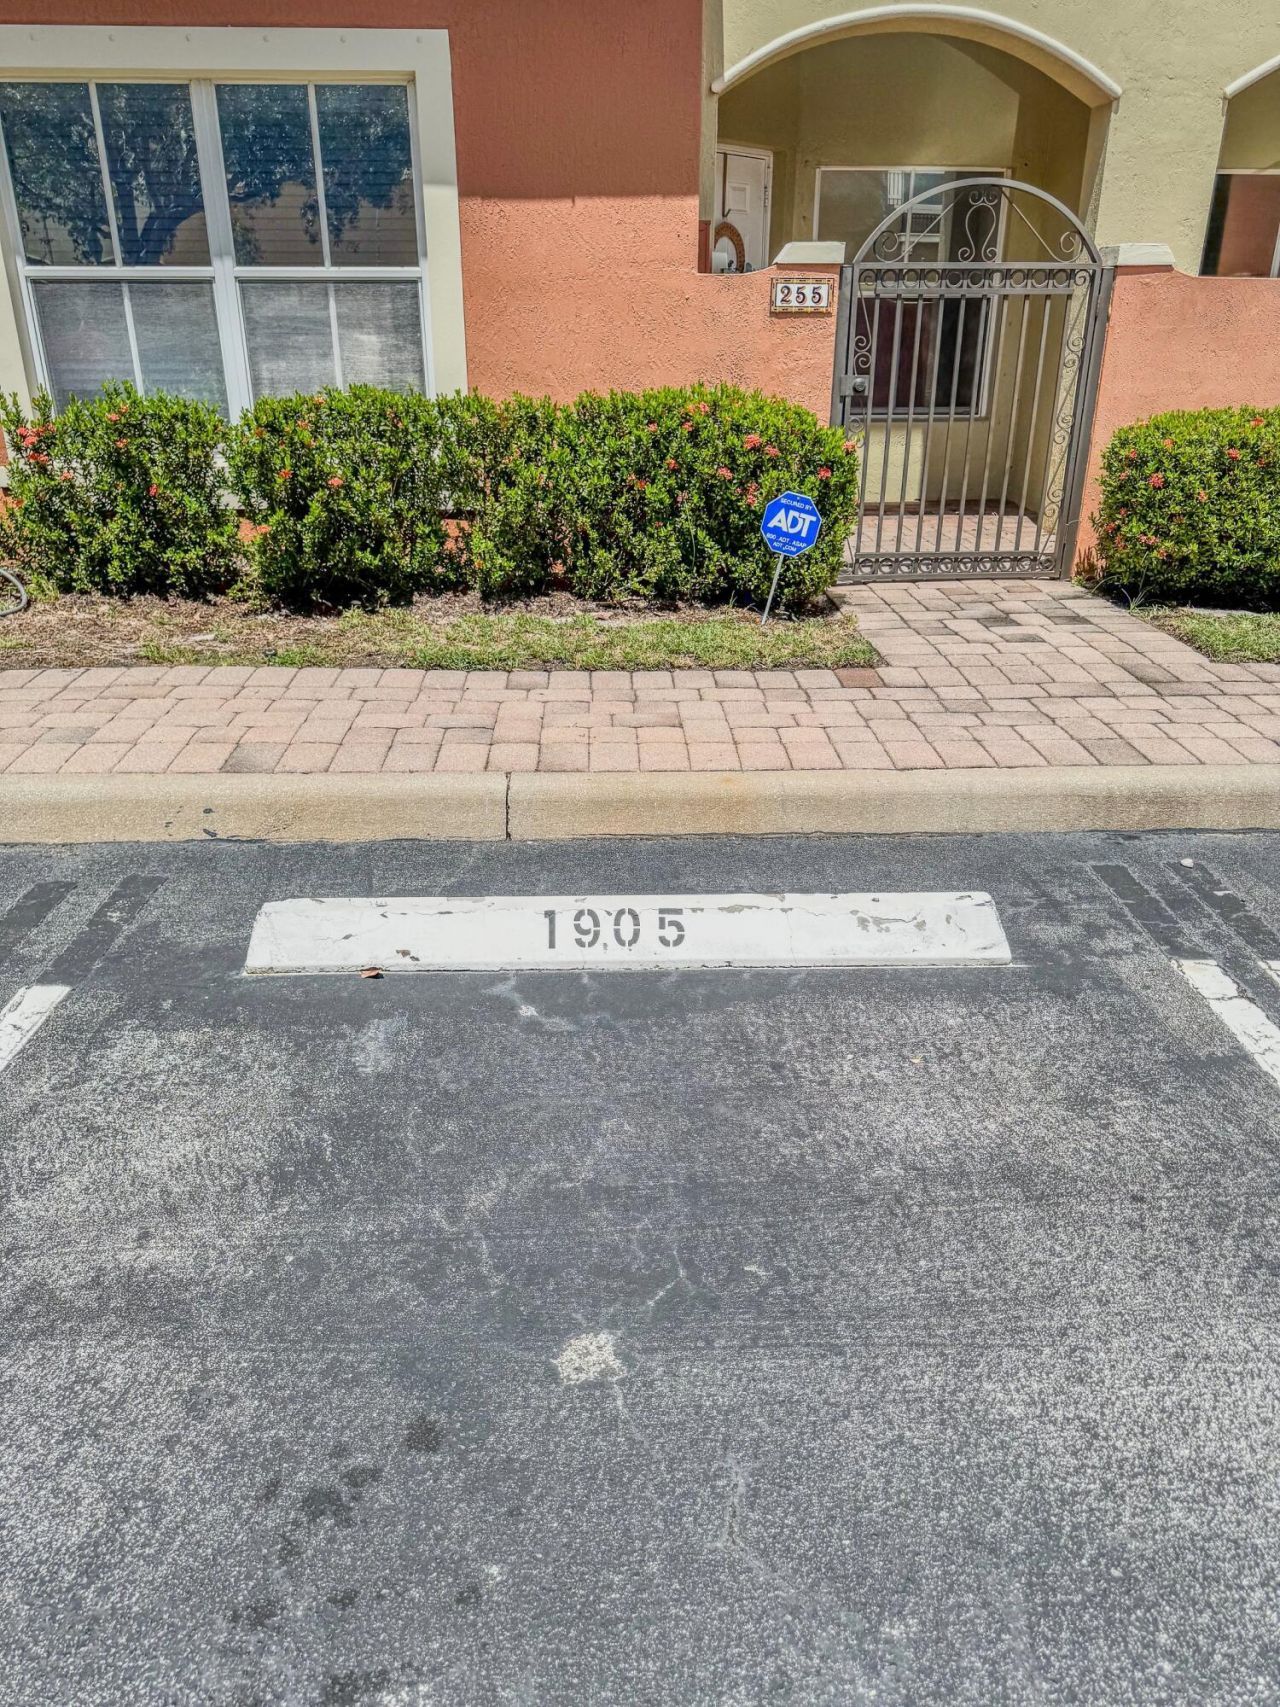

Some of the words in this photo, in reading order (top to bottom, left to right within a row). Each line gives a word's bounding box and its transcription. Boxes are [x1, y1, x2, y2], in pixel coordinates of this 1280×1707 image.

[780, 285, 822, 304] 255
[780, 498, 805, 509] SECURED
[767, 507, 817, 538] ADT
[544, 908, 685, 949] 1905
